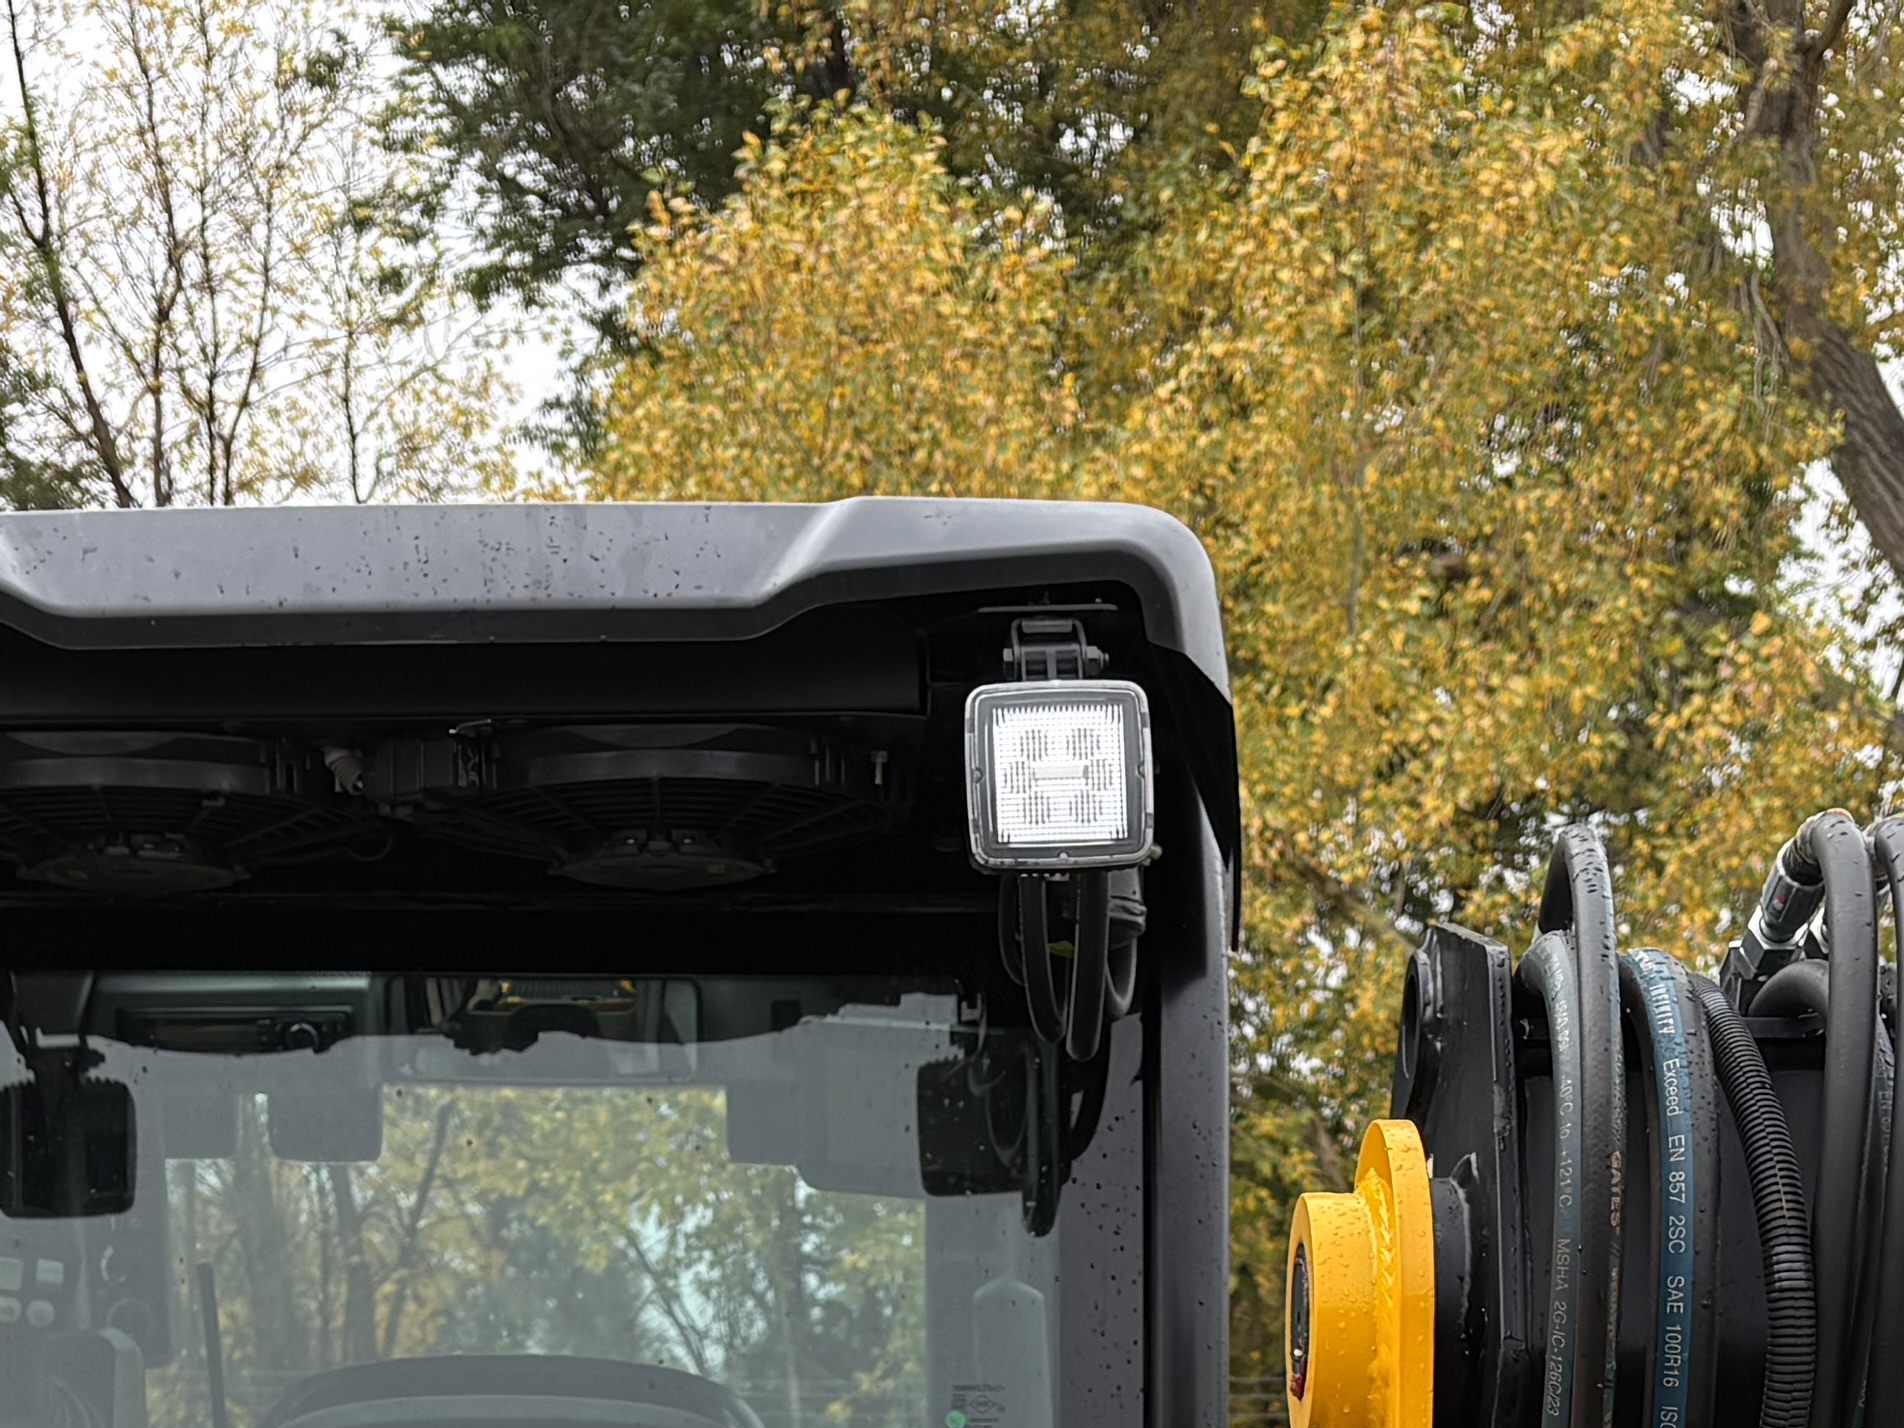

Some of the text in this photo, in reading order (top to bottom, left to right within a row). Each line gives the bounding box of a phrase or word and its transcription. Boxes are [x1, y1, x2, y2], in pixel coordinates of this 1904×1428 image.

[1663, 1059, 1683, 1116] Exceed
[1879, 1091, 1893, 1109] EN
[1559, 1123, 1572, 1139] to
[1668, 1135, 1686, 1162] EN
[1609, 1151, 1622, 1227] GATES
[1669, 1171, 1686, 1204] 857
[1667, 1215, 1686, 1254] 2SC
[1554, 1239, 1572, 1291] MSHA
[1666, 1275, 1685, 1314] SAE
[1662, 1324, 1683, 1387] 100R16
